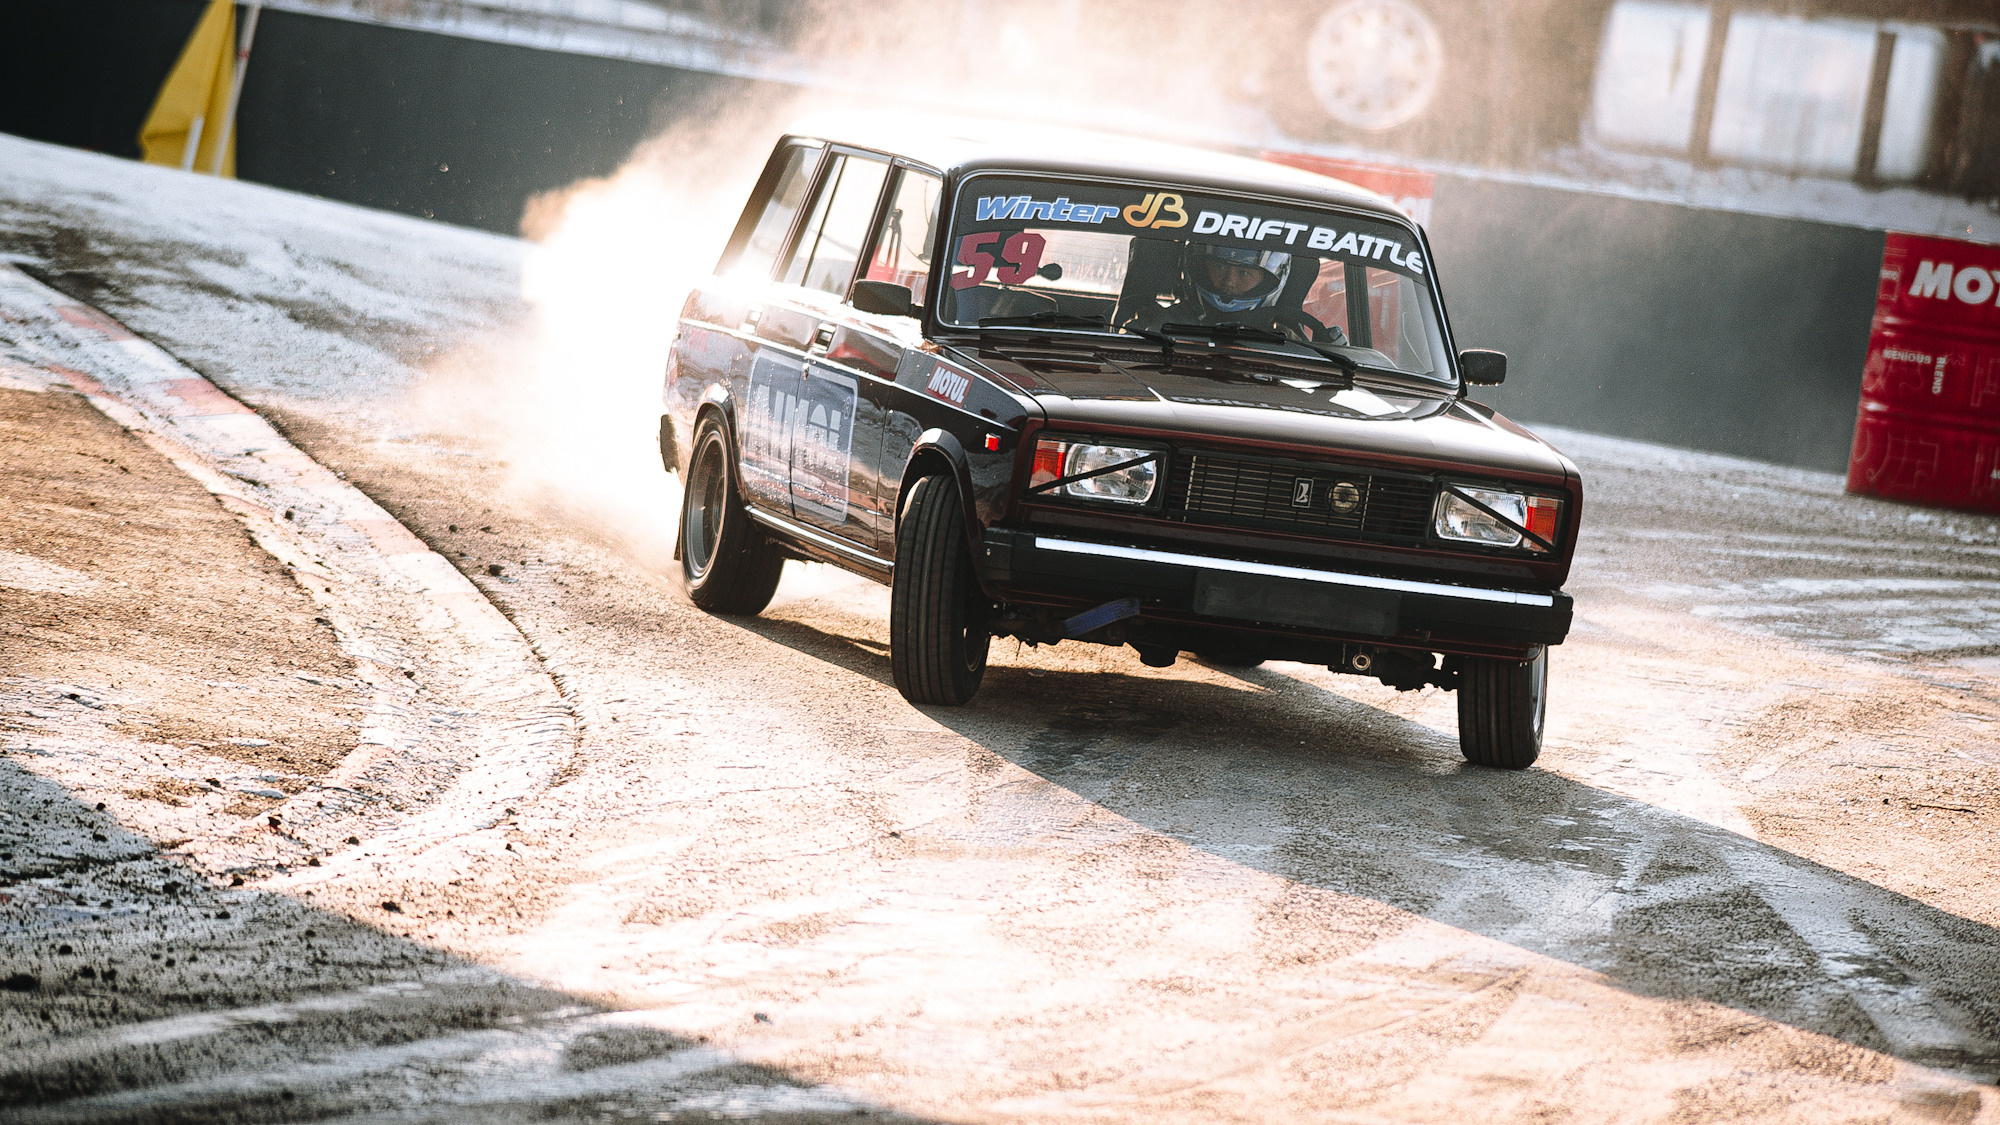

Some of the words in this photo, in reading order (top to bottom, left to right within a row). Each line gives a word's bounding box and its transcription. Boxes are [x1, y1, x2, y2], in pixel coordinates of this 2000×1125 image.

[951, 231, 1046, 292] 59
[976, 194, 1120, 225] Winter
[1193, 211, 1308, 247] DRIFT
[1306, 226, 1424, 276] BATTLE
[928, 366, 970, 404] MOTUL
